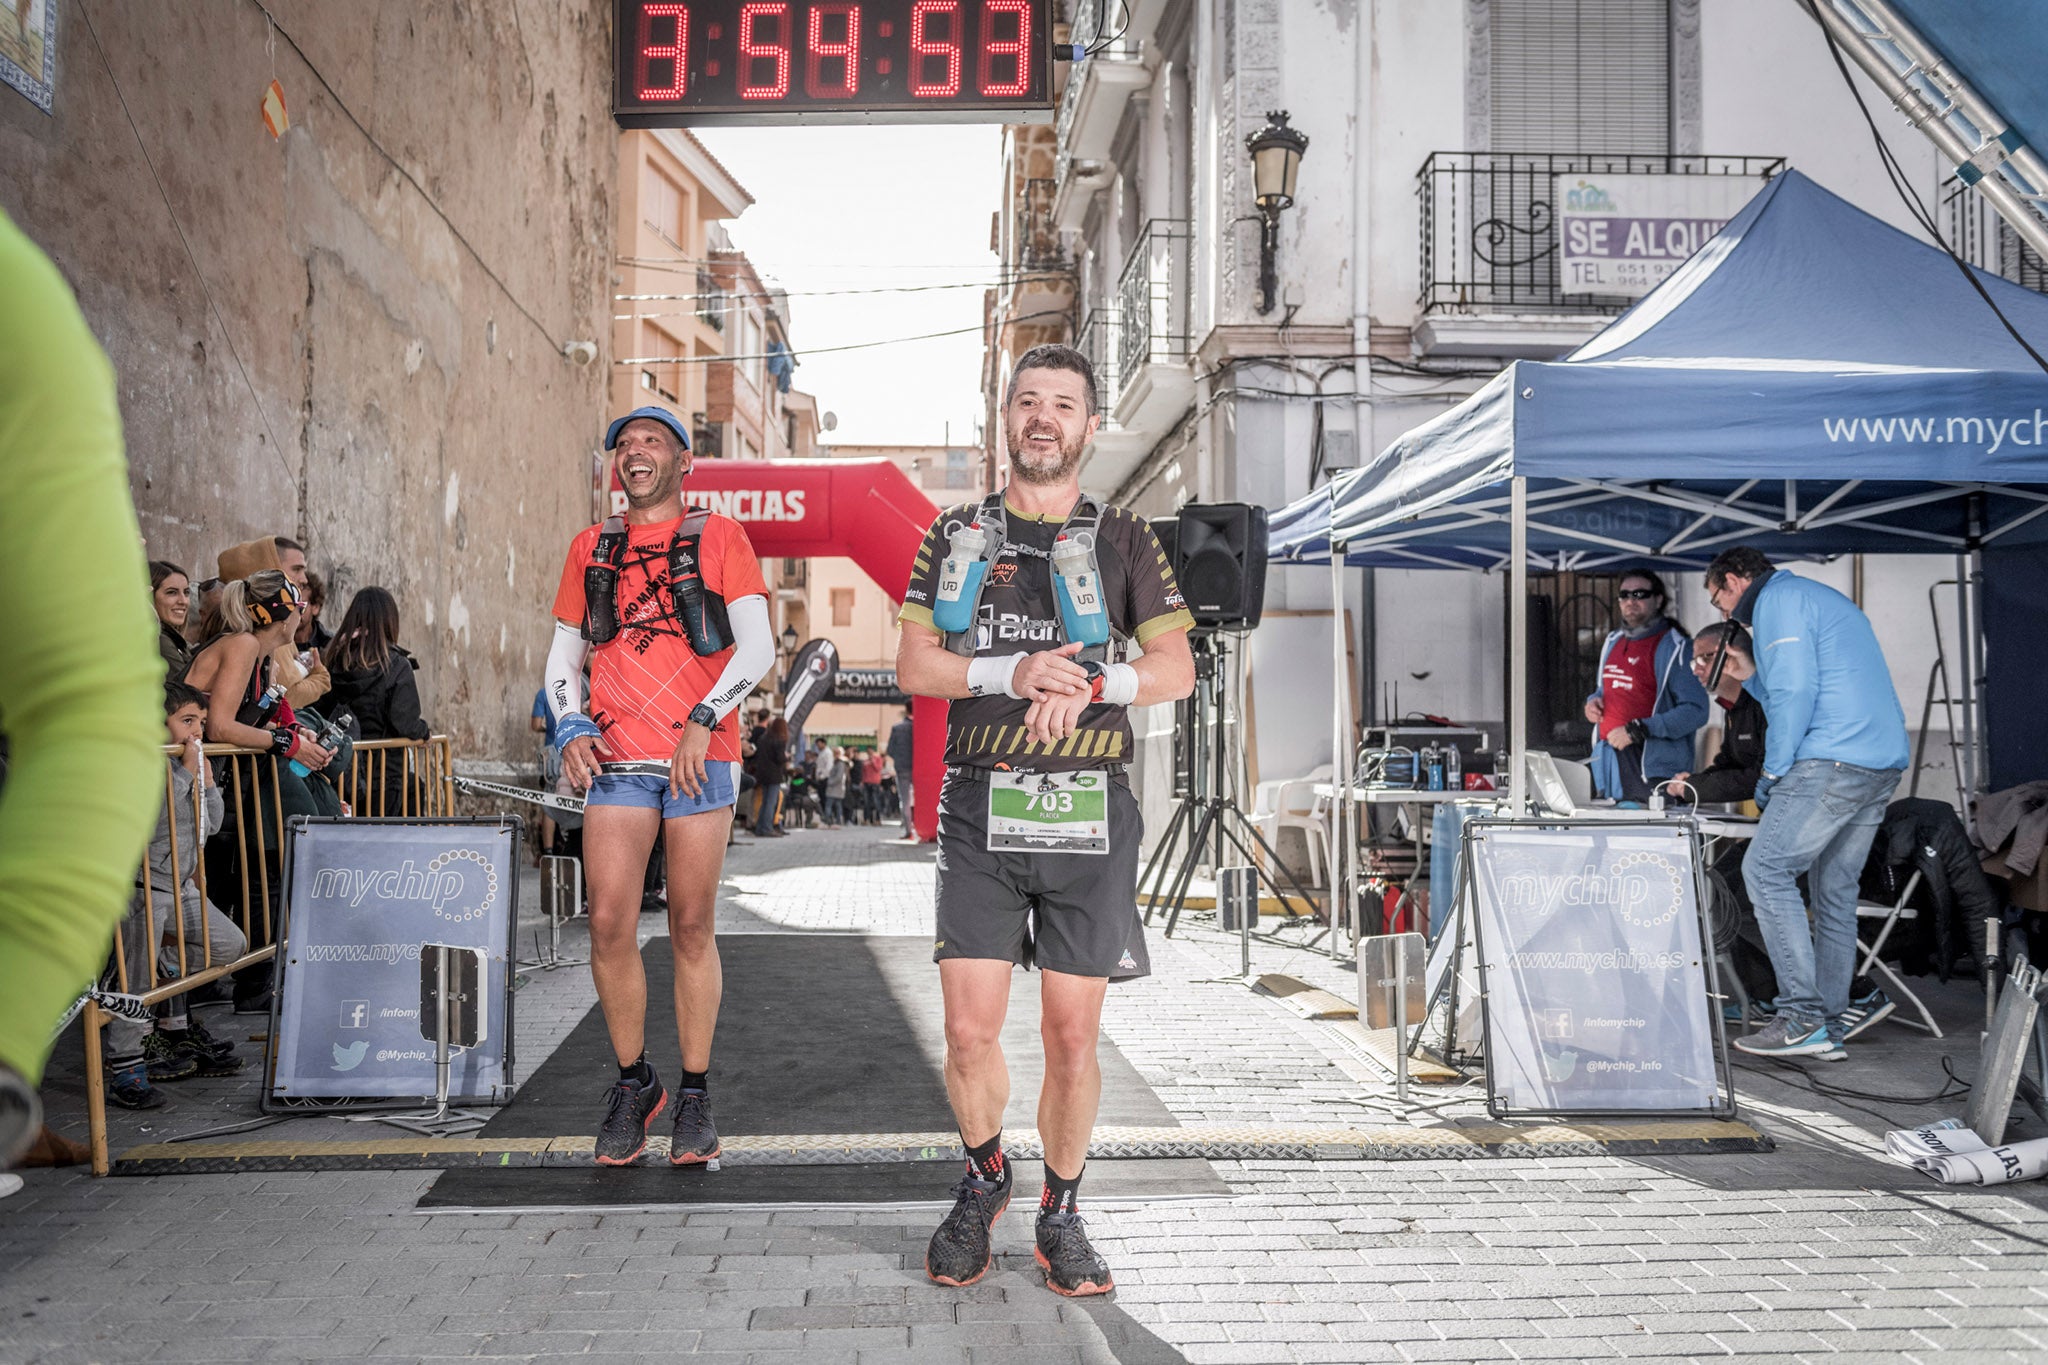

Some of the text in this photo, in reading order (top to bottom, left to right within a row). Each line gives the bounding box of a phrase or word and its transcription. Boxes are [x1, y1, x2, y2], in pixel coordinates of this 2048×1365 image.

[1568, 220, 1610, 255] SE
[1025, 792, 1074, 813] 703
[311, 860, 464, 910] mychip
[1499, 864, 1650, 914] mychip
[1503, 948, 1686, 975] www.mychip.es
